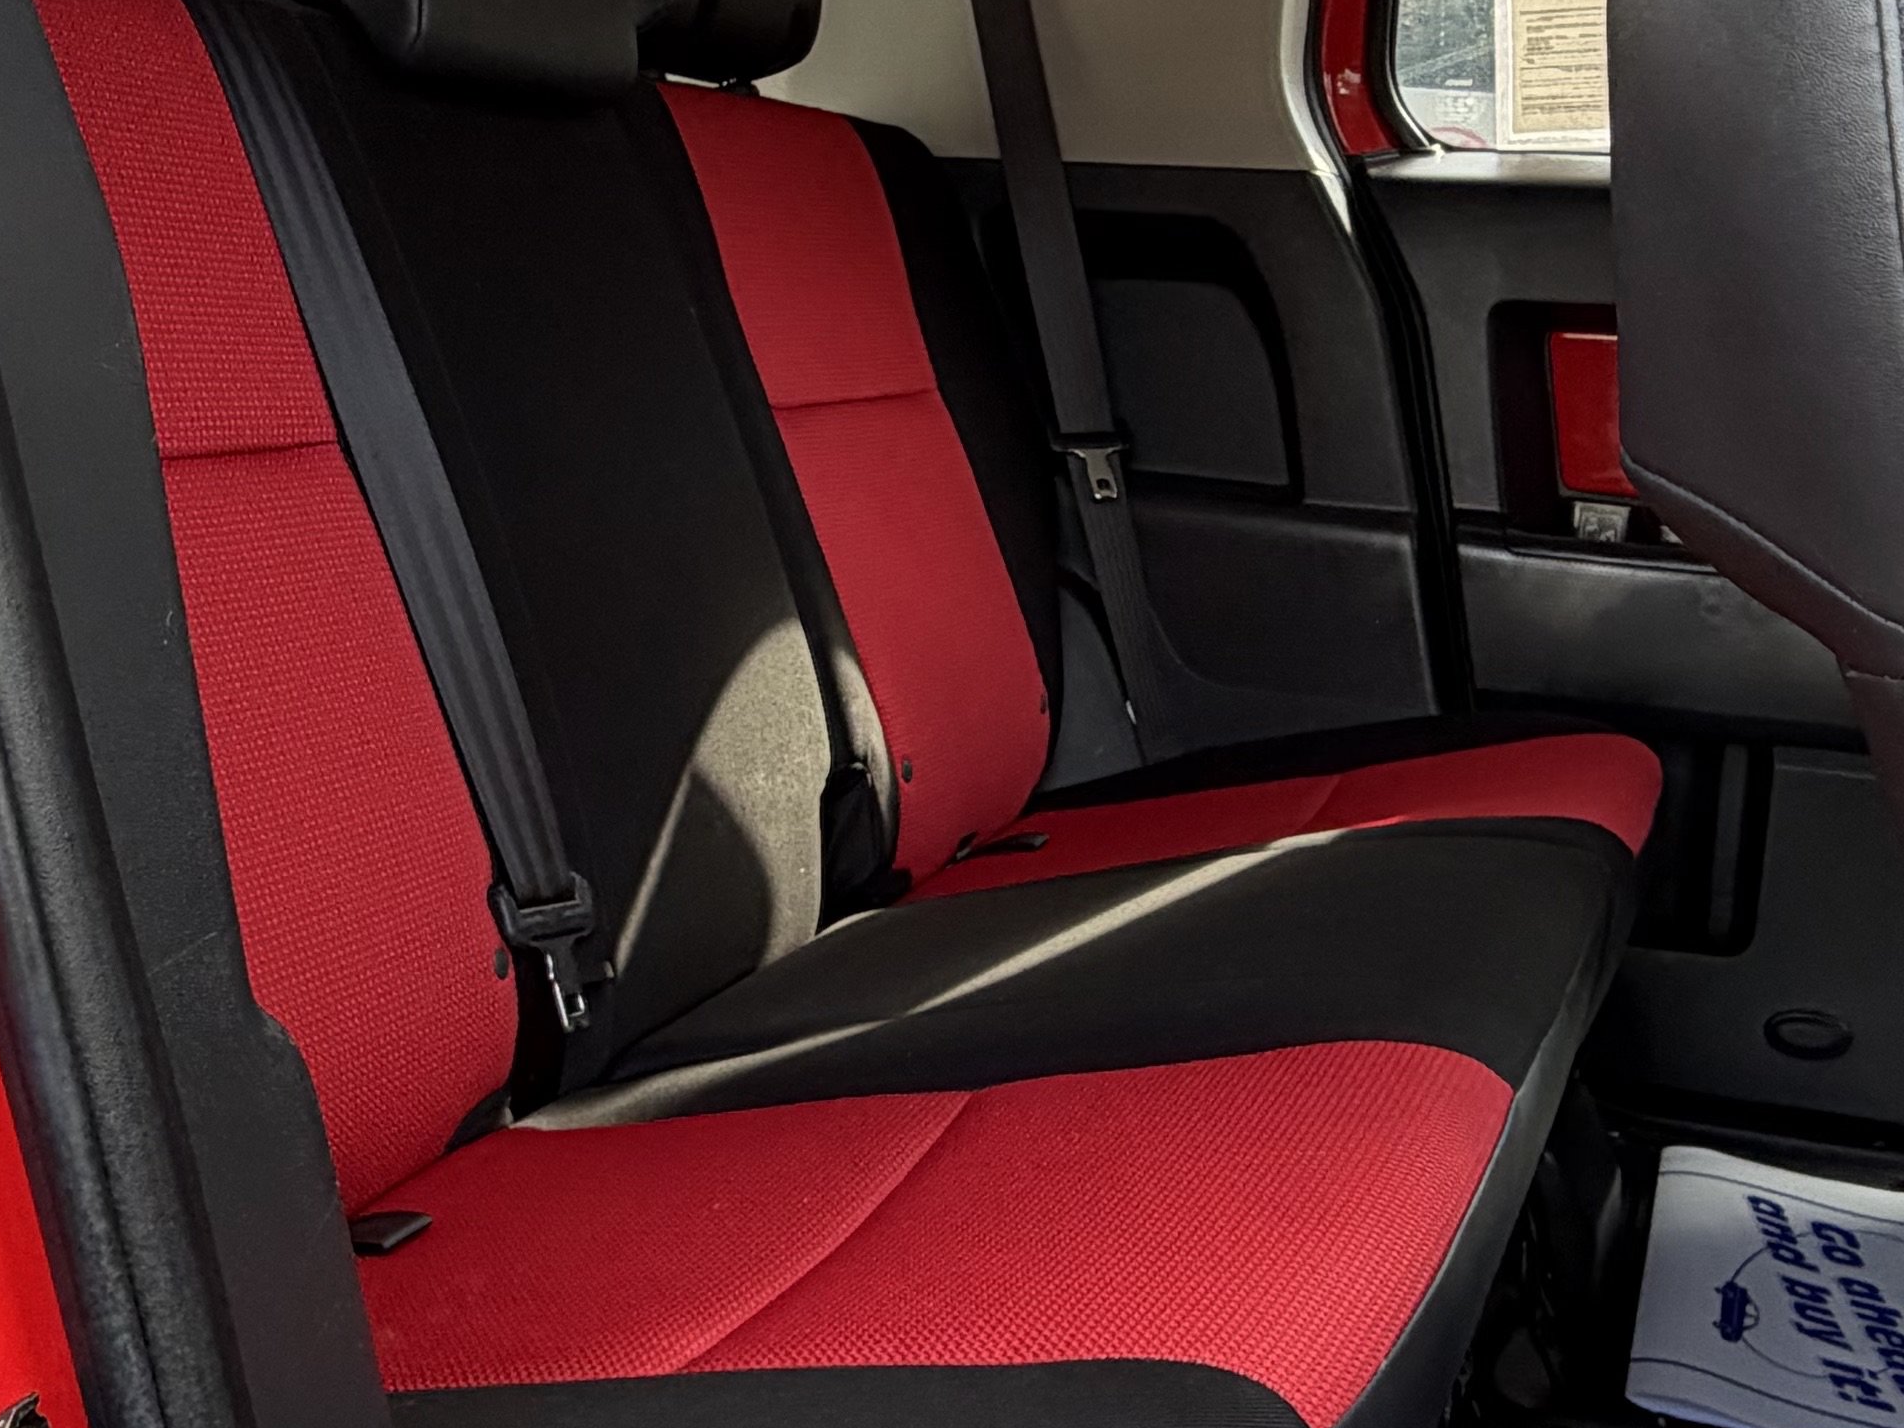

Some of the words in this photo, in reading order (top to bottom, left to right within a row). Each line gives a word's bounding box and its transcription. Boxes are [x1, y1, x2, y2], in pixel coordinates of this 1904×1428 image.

[1746, 1195, 1821, 1273] and
[1781, 1272, 1853, 1352] buy
[1819, 1355, 1897, 1414] it!
